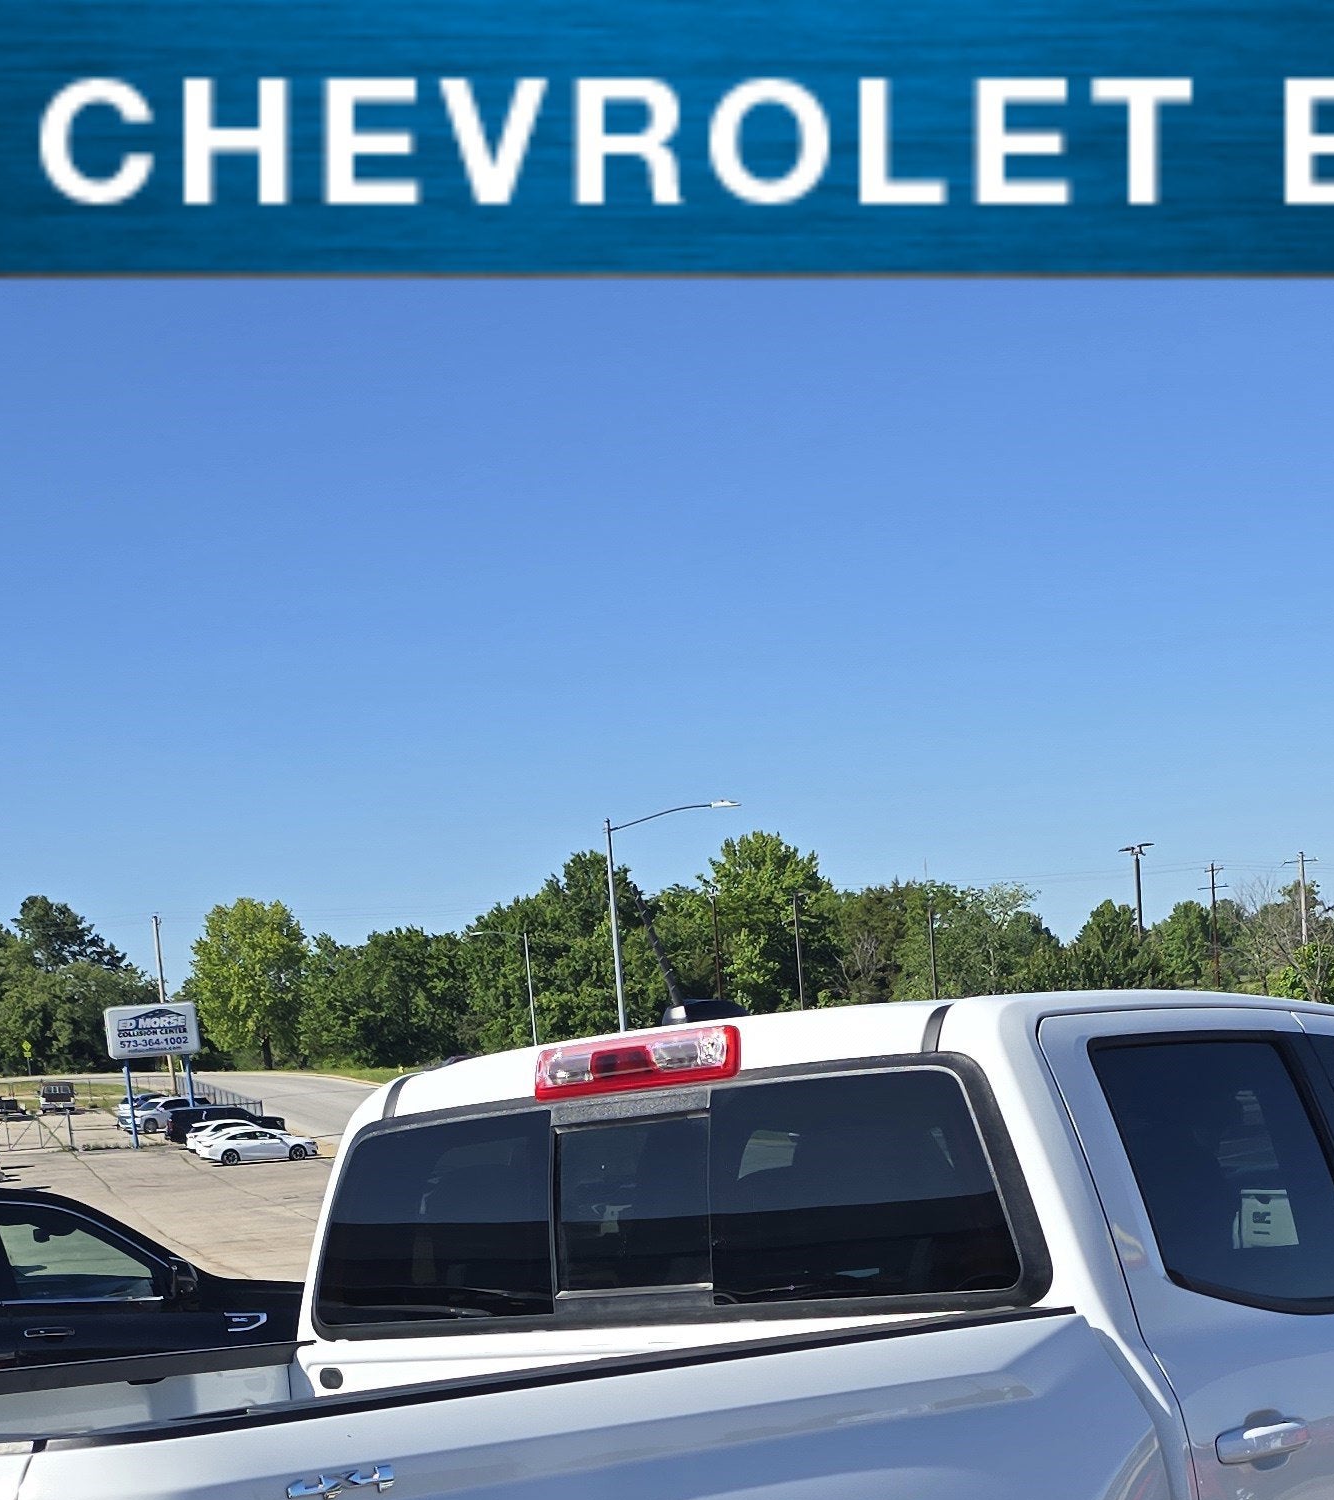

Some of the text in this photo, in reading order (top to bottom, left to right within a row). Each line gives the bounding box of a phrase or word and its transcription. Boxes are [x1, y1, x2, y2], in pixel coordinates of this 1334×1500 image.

[119, 1014, 186, 1031] ED MORSE
[118, 1027, 187, 1038] COLLISION CENTER
[120, 1037, 189, 1048] 573-364-1002
